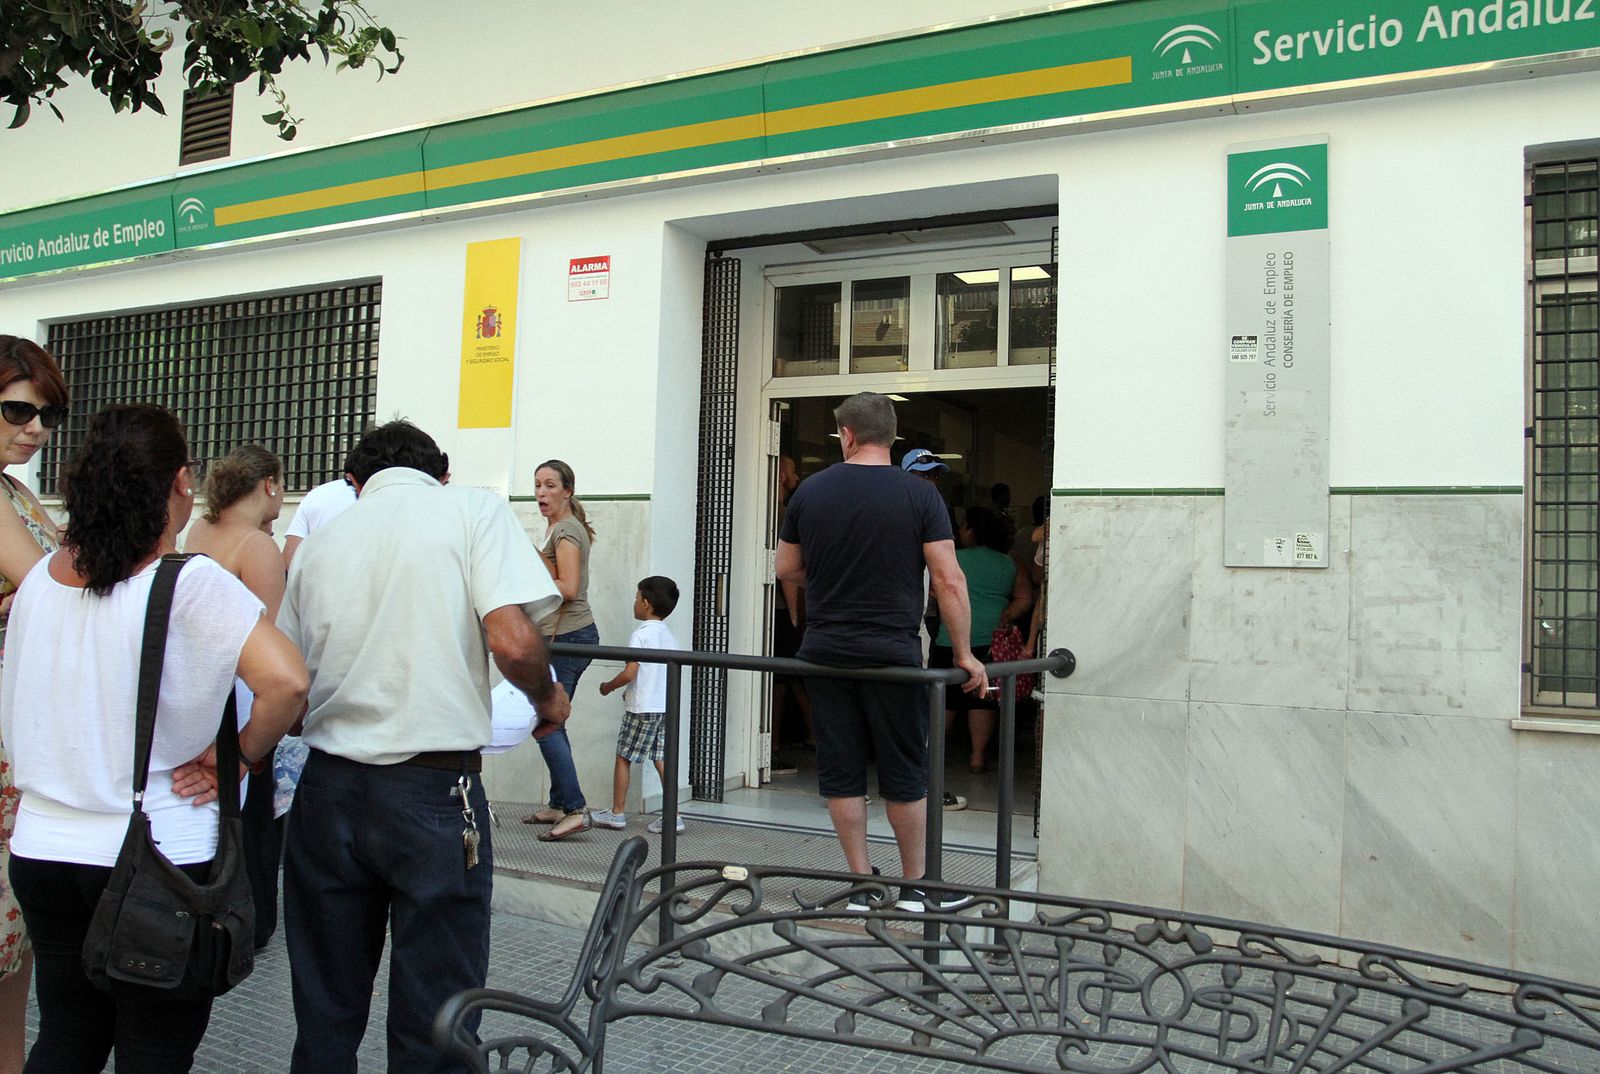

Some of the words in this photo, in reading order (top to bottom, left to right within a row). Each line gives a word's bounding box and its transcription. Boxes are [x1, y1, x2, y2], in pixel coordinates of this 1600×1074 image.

[1252, 14, 1404, 66] Servicio
[1415, 0, 1597, 43] Andaluz
[1151, 70, 1172, 80] JUNTA
[1175, 68, 1184, 77] DE
[1243, 202, 1264, 212] JUNTA
[1266, 201, 1275, 209] DE
[0, 241, 34, 265] rvicio
[37, 233, 90, 259] Andaluz
[93, 227, 110, 248] de
[113, 218, 165, 247] Empleo
[571, 262, 608, 273] ALARMA
[1263, 252, 1279, 295] Empleo
[1283, 251, 1293, 291] EMPLEO
[1263, 300, 1276, 315] de
[1283, 294, 1293, 307] DE
[1263, 320, 1276, 368] Andaluz
[1263, 372, 1276, 417] Servicio
